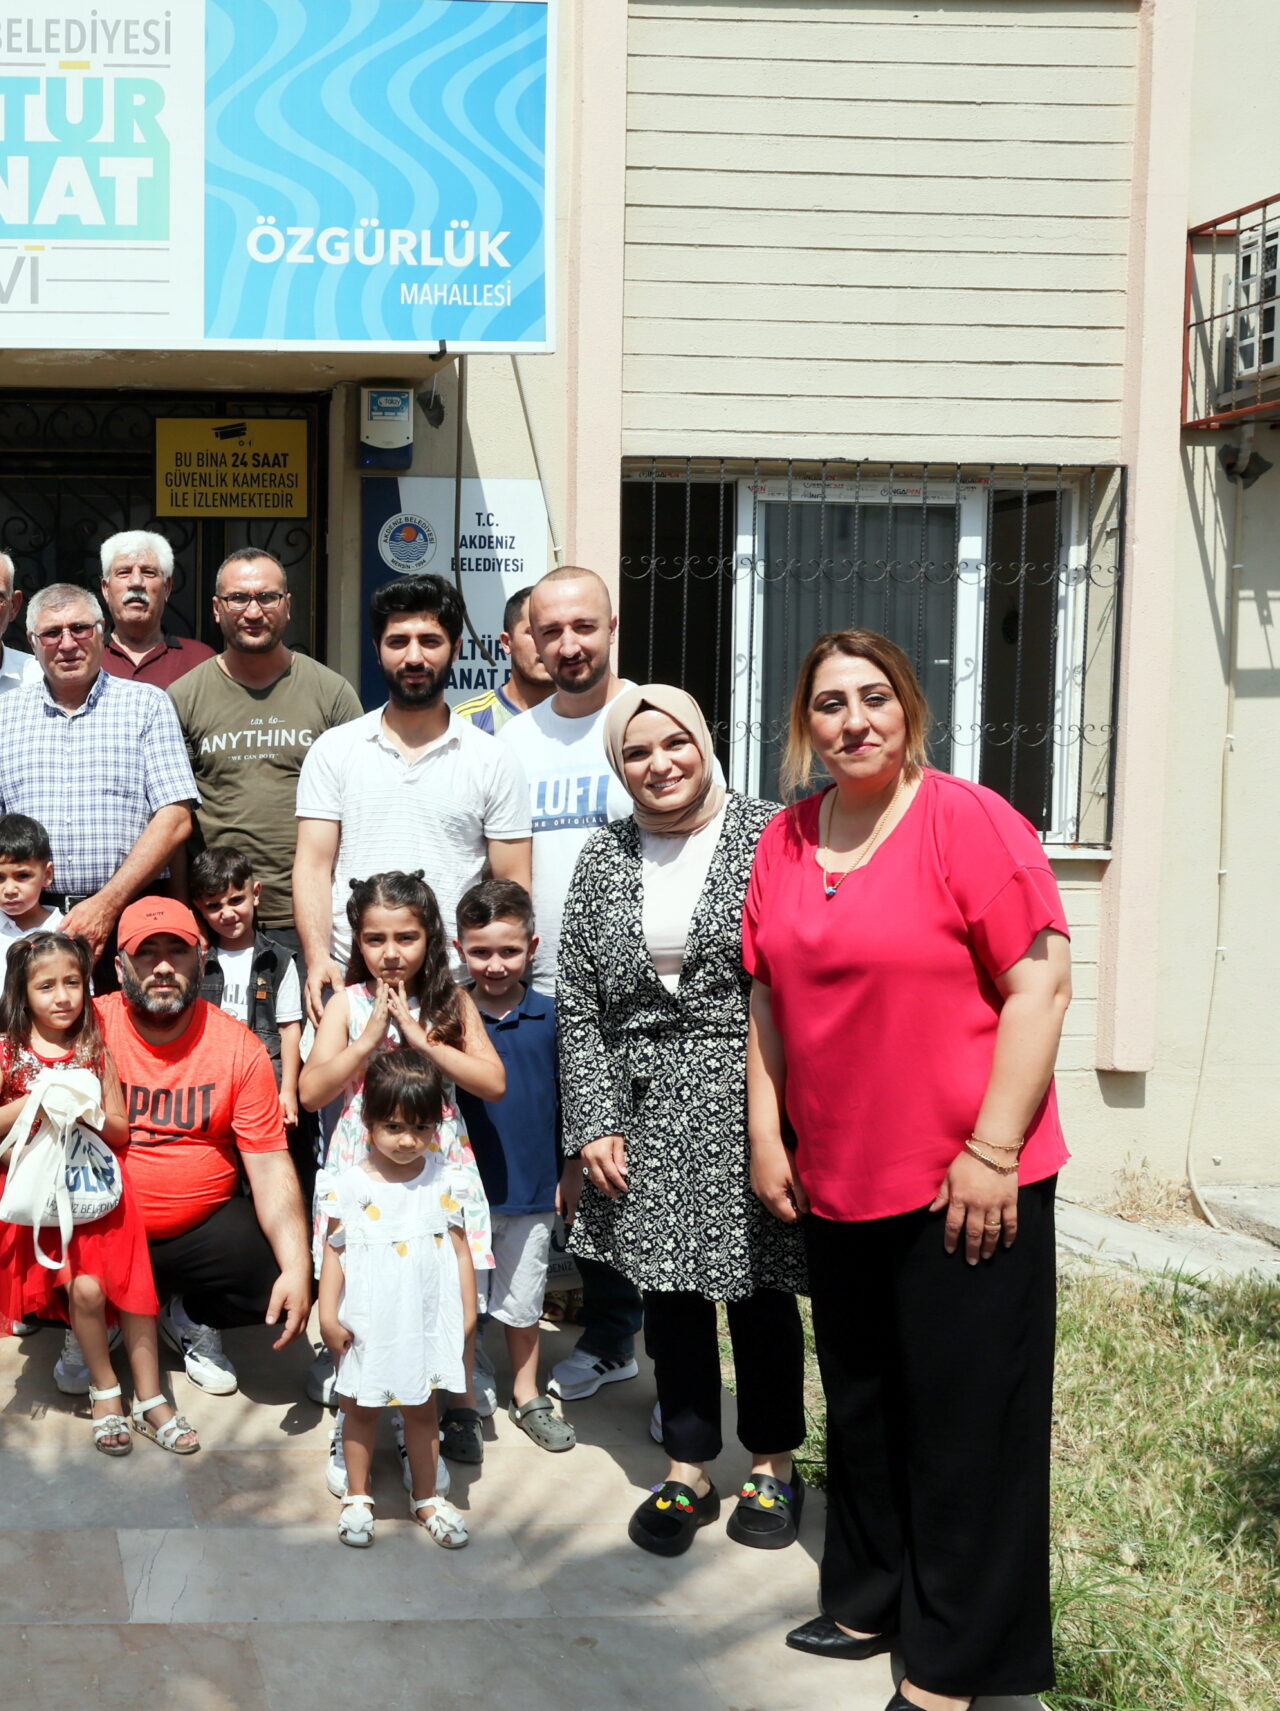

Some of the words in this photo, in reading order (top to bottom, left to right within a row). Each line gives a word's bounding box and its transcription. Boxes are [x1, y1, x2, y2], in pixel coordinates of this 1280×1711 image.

[246, 215, 512, 268] ÖZGÜRLÜK
[400, 280, 512, 307] MAHALLESİ
[175, 451, 192, 468] BU
[197, 449, 228, 468] BİNA
[231, 453, 248, 468] 24
[252, 453, 289, 468] SAAT
[165, 469, 229, 488] GÜVENLİK
[232, 472, 299, 489] KAMERASI
[170, 489, 190, 508] İLE
[193, 489, 294, 509] İZLENMEKTEDİR
[475, 512, 499, 527] T.C.
[458, 634, 507, 661] LTÜR
[445, 668, 499, 690] ANAT
[200, 728, 314, 756] ANYTHING
